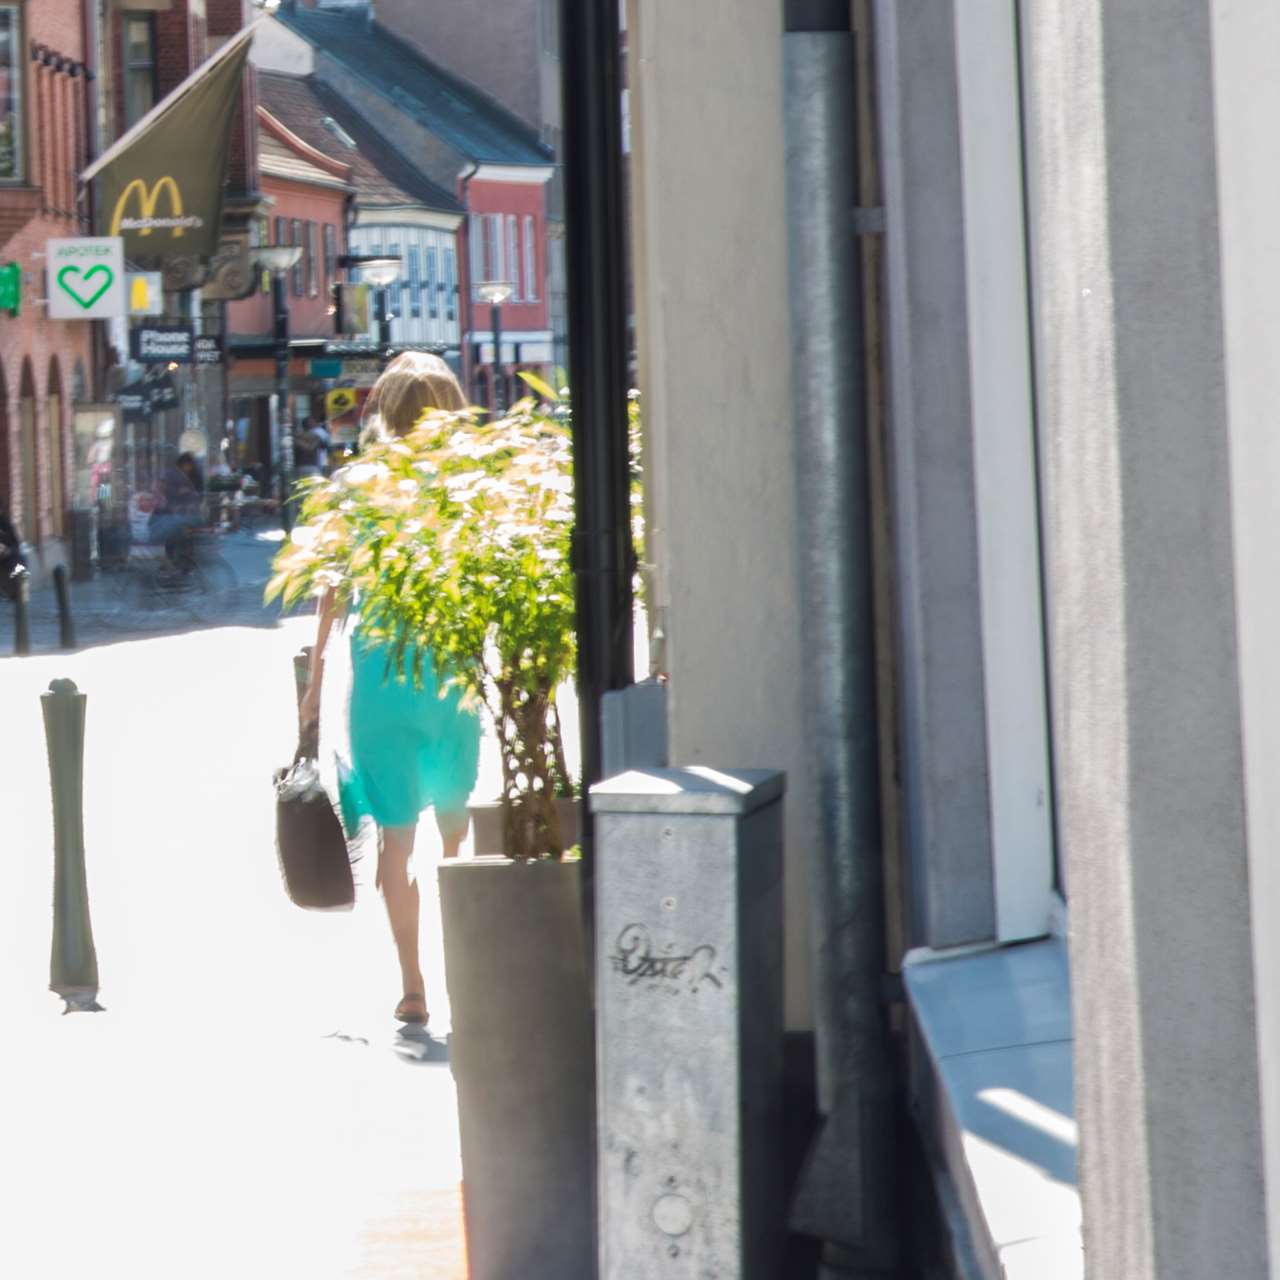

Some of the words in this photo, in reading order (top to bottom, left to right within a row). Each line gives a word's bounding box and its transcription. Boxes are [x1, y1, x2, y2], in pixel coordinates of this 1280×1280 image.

[121, 215, 203, 229] McDonald's
[57, 245, 113, 257] APOTEK
[141, 329, 191, 342] Phone
[141, 343, 191, 354] House
